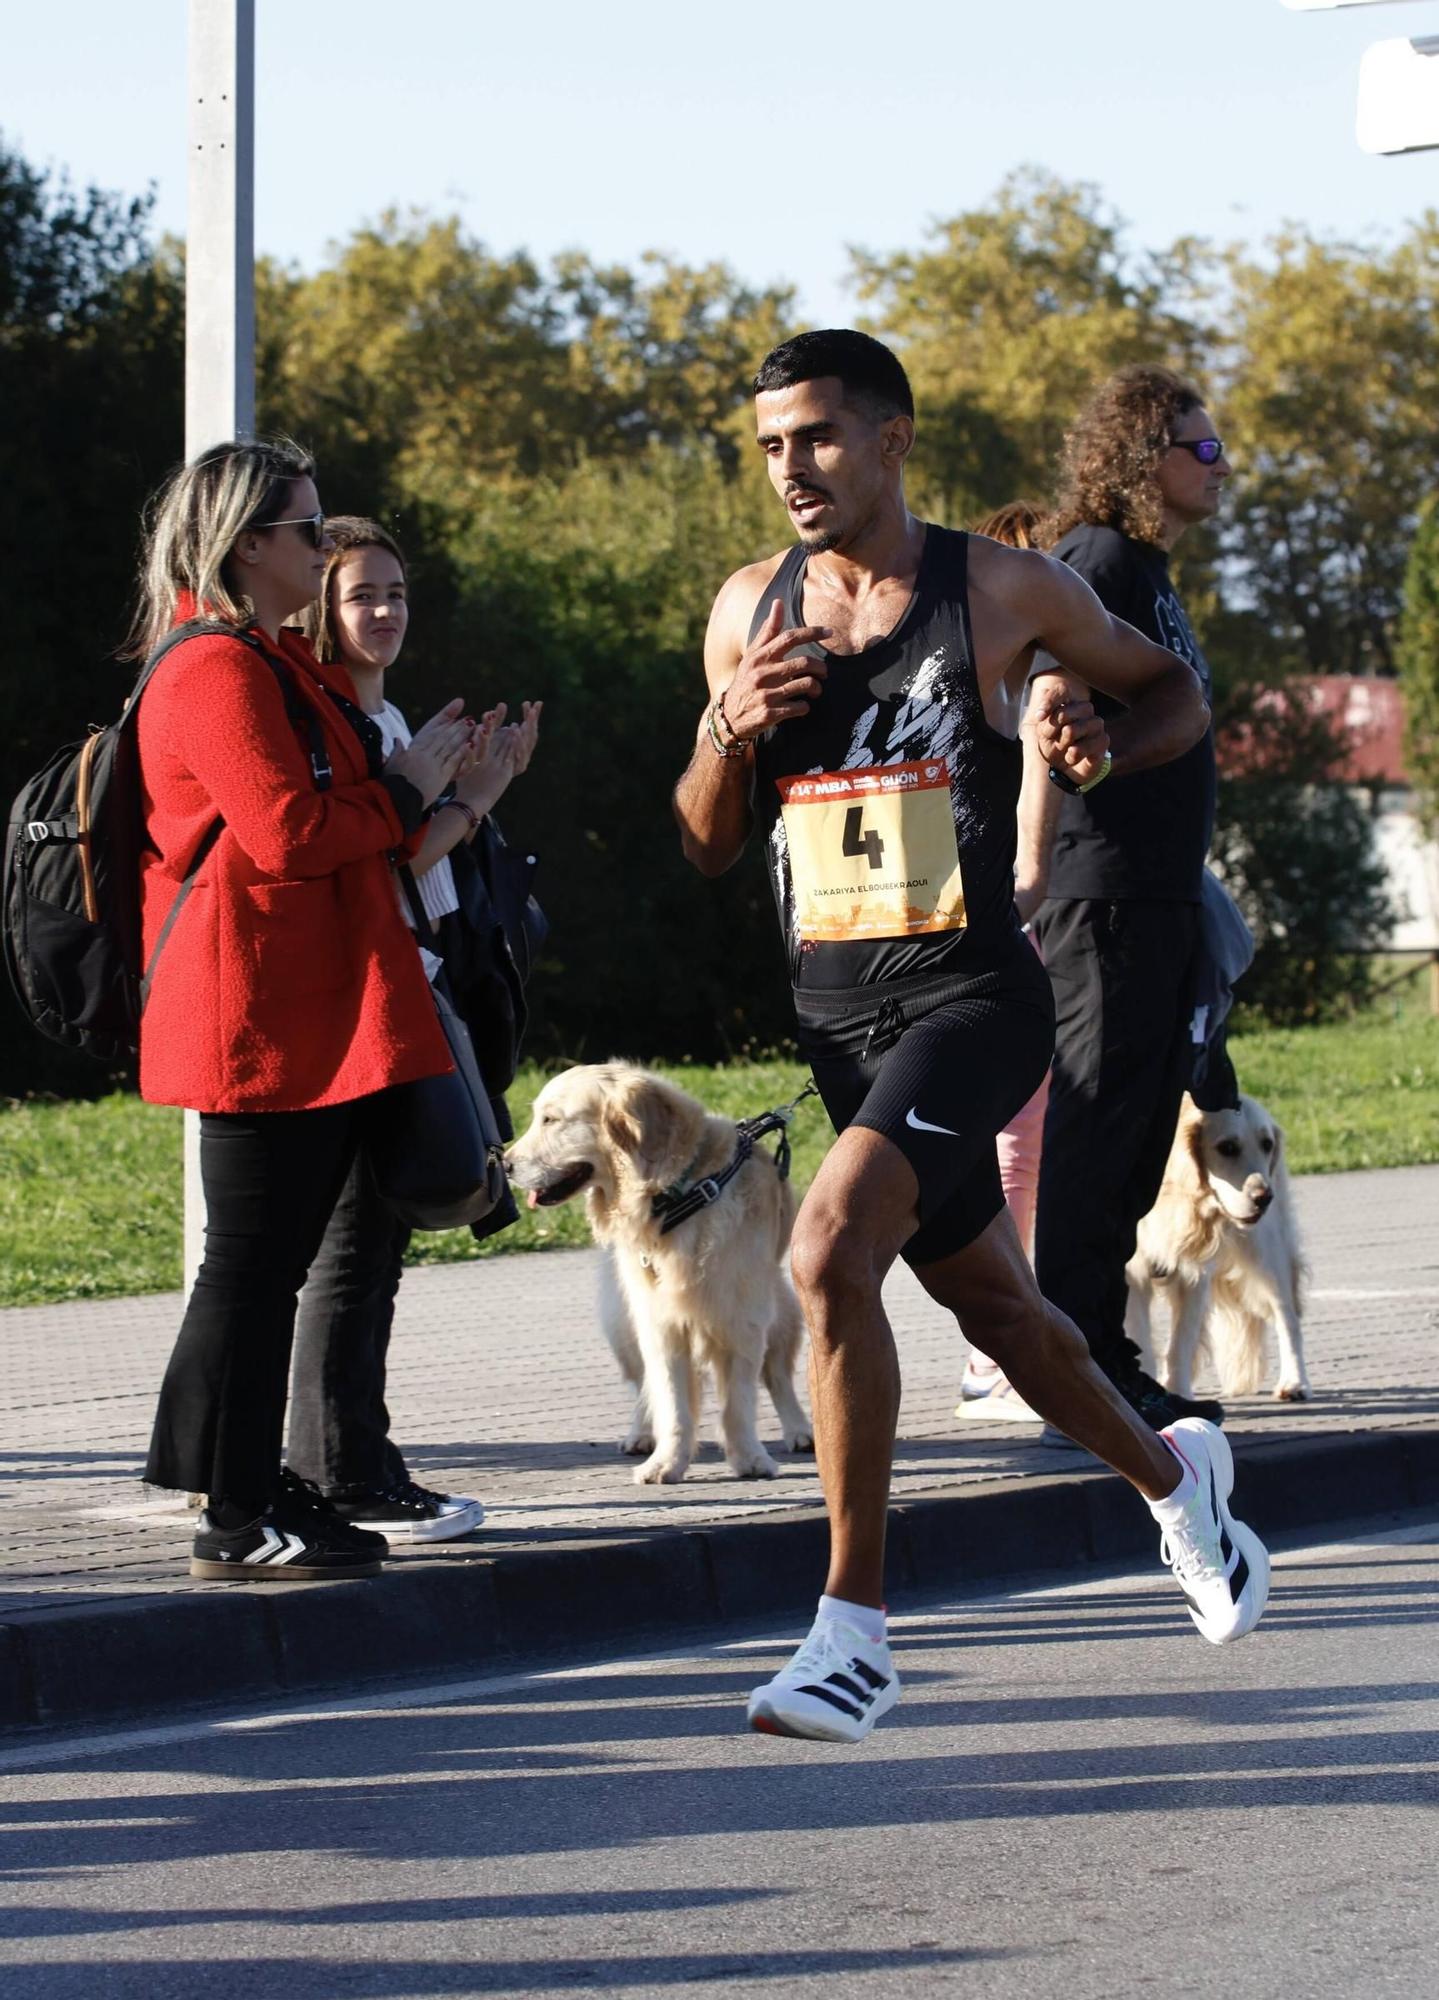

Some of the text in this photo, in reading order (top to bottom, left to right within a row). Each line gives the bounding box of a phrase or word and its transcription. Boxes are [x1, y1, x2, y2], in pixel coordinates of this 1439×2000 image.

[815, 780, 853, 795] MBA
[880, 771, 919, 787] GIJÓN
[842, 806, 885, 870] 4
[814, 886, 856, 897] ZAKARIYA
